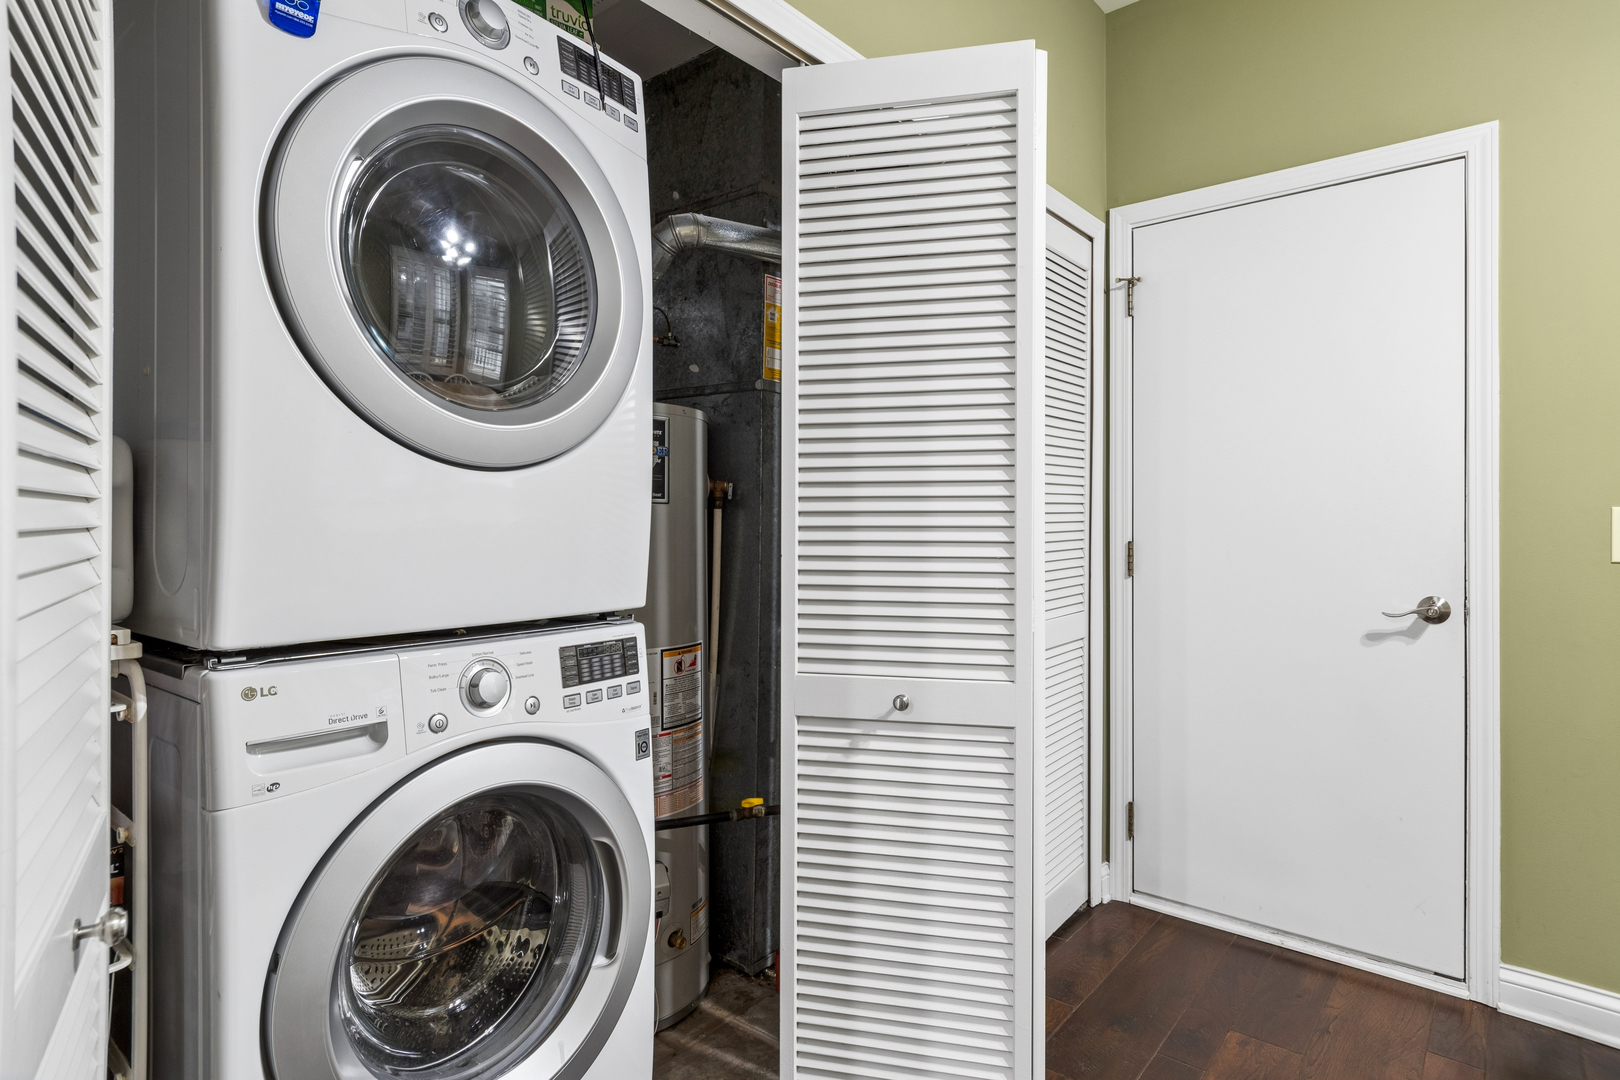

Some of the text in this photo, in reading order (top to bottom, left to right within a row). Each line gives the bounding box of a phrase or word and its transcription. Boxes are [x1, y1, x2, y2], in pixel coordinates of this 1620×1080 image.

[260, 685, 278, 698] LG
[328, 716, 349, 725] Direct
[350, 713, 369, 721] Drive
